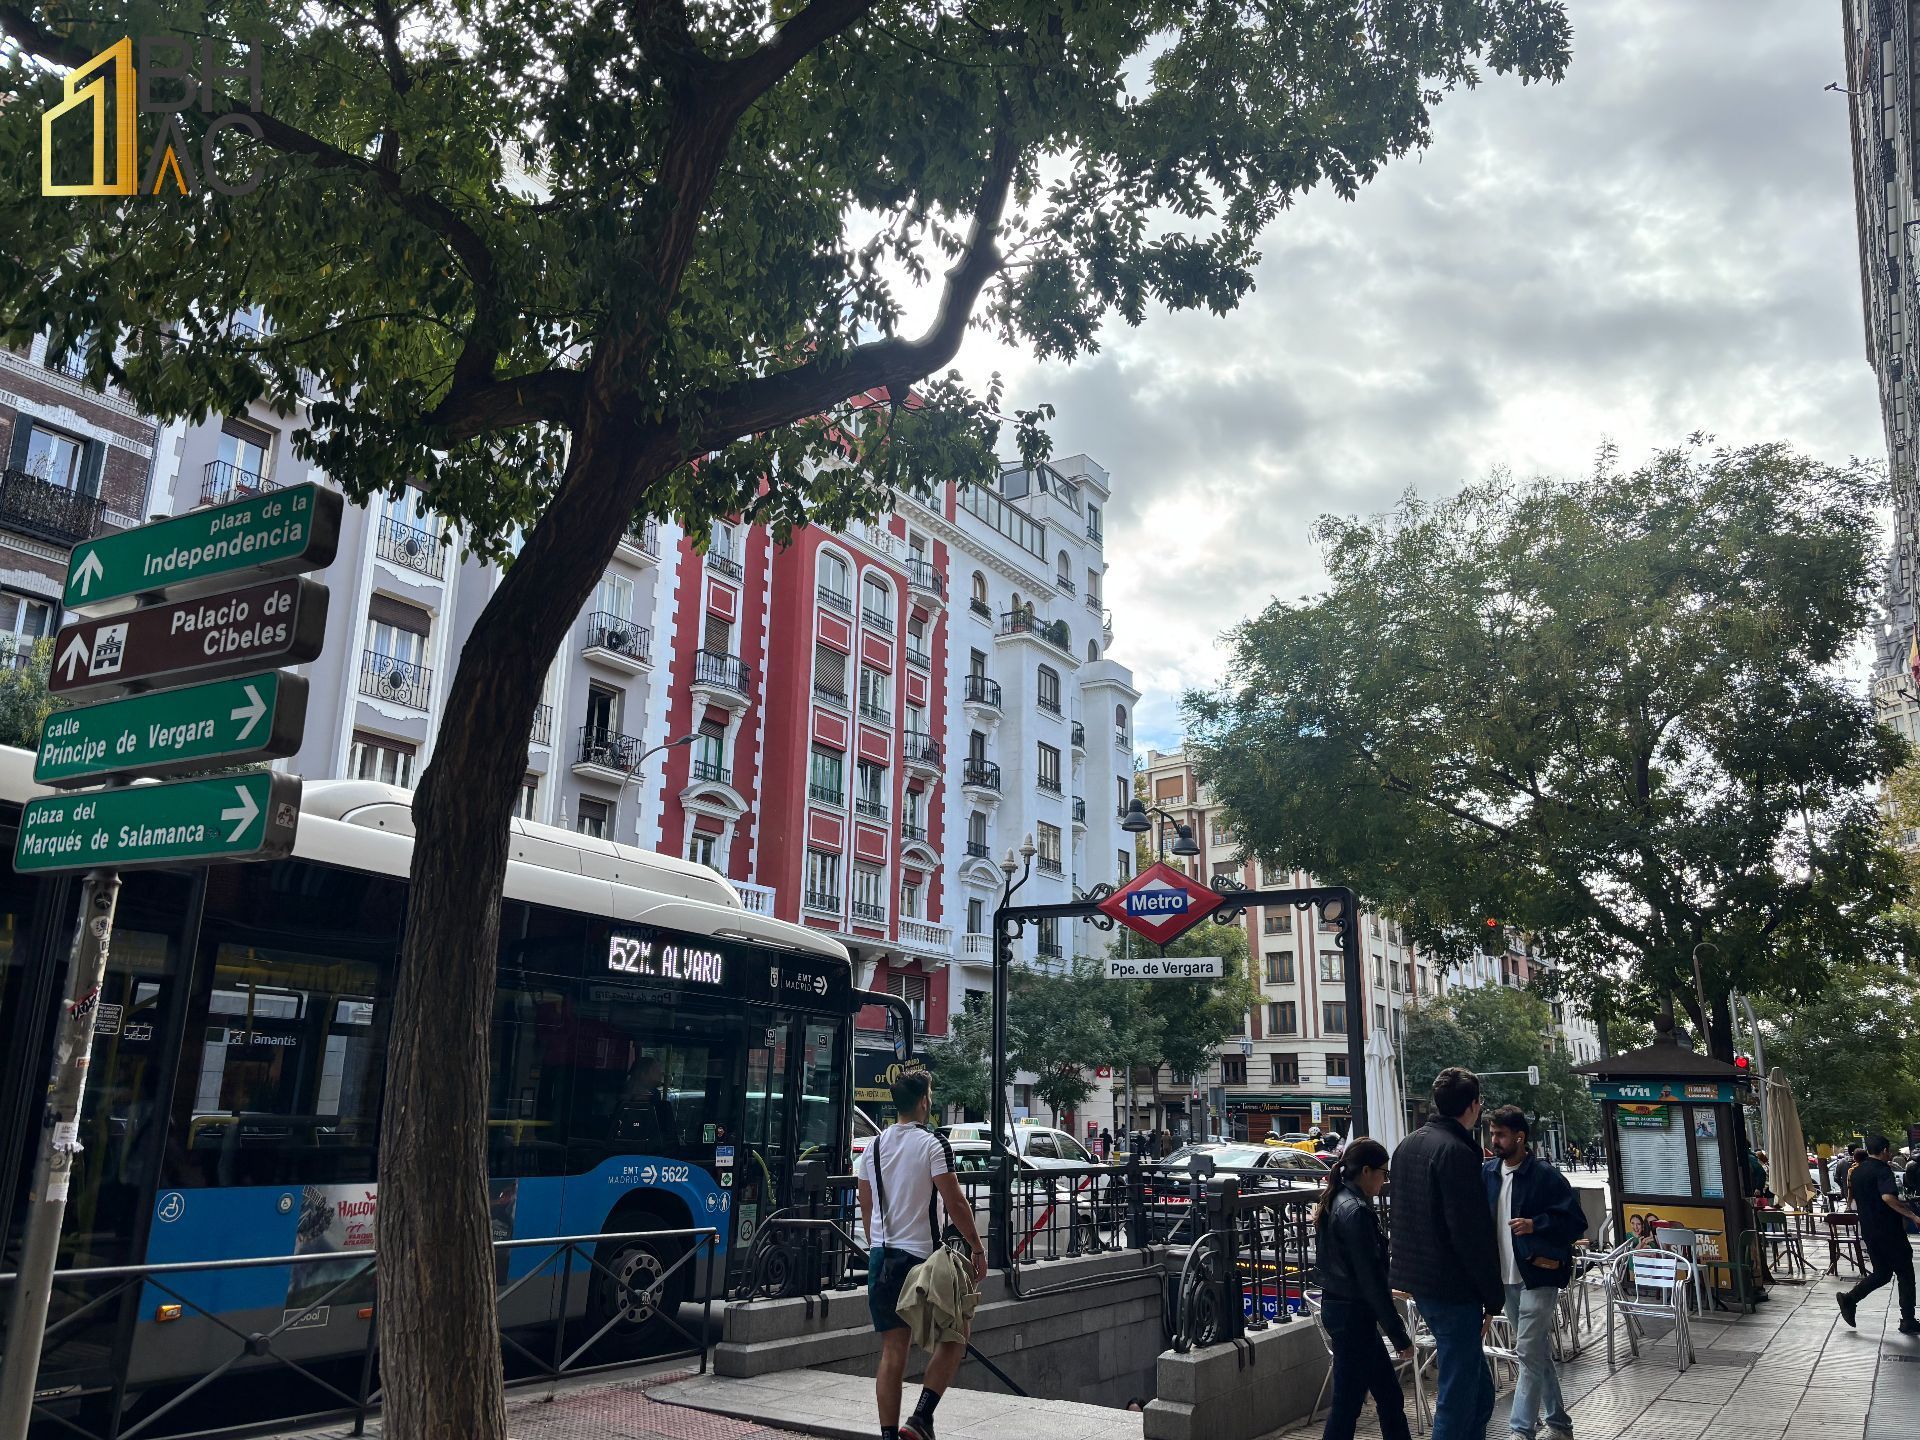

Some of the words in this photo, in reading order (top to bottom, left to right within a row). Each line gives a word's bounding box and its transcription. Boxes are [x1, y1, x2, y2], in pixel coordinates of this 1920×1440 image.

[210, 511, 251, 535] plaza
[262, 501, 281, 518] de
[292, 495, 307, 511] la
[143, 520, 302, 576] Independencia
[170, 598, 249, 635] Palacio
[264, 590, 291, 616] de
[203, 622, 287, 655] Cibeles
[47, 718, 80, 738] calle
[42, 737, 106, 767] Príncipe
[116, 730, 137, 754] de
[149, 719, 215, 749] Vergara
[27, 807, 63, 828] plaza
[73, 802, 96, 821] del
[22, 830, 81, 856] Marqués
[91, 828, 109, 850] de
[118, 824, 205, 848] Salamanca
[1131, 894, 1183, 911] Metro
[661, 945, 722, 984] ALVARO
[797, 972, 812, 983] EMT
[1111, 963, 1139, 977] Ppe.
[1142, 962, 1158, 975] de
[1162, 961, 1214, 976] Vergara
[785, 979, 812, 992] MADRID
[608, 1175, 639, 1184] MADRID
[623, 1166, 639, 1175] EMT
[661, 1166, 689, 1183] 5622
